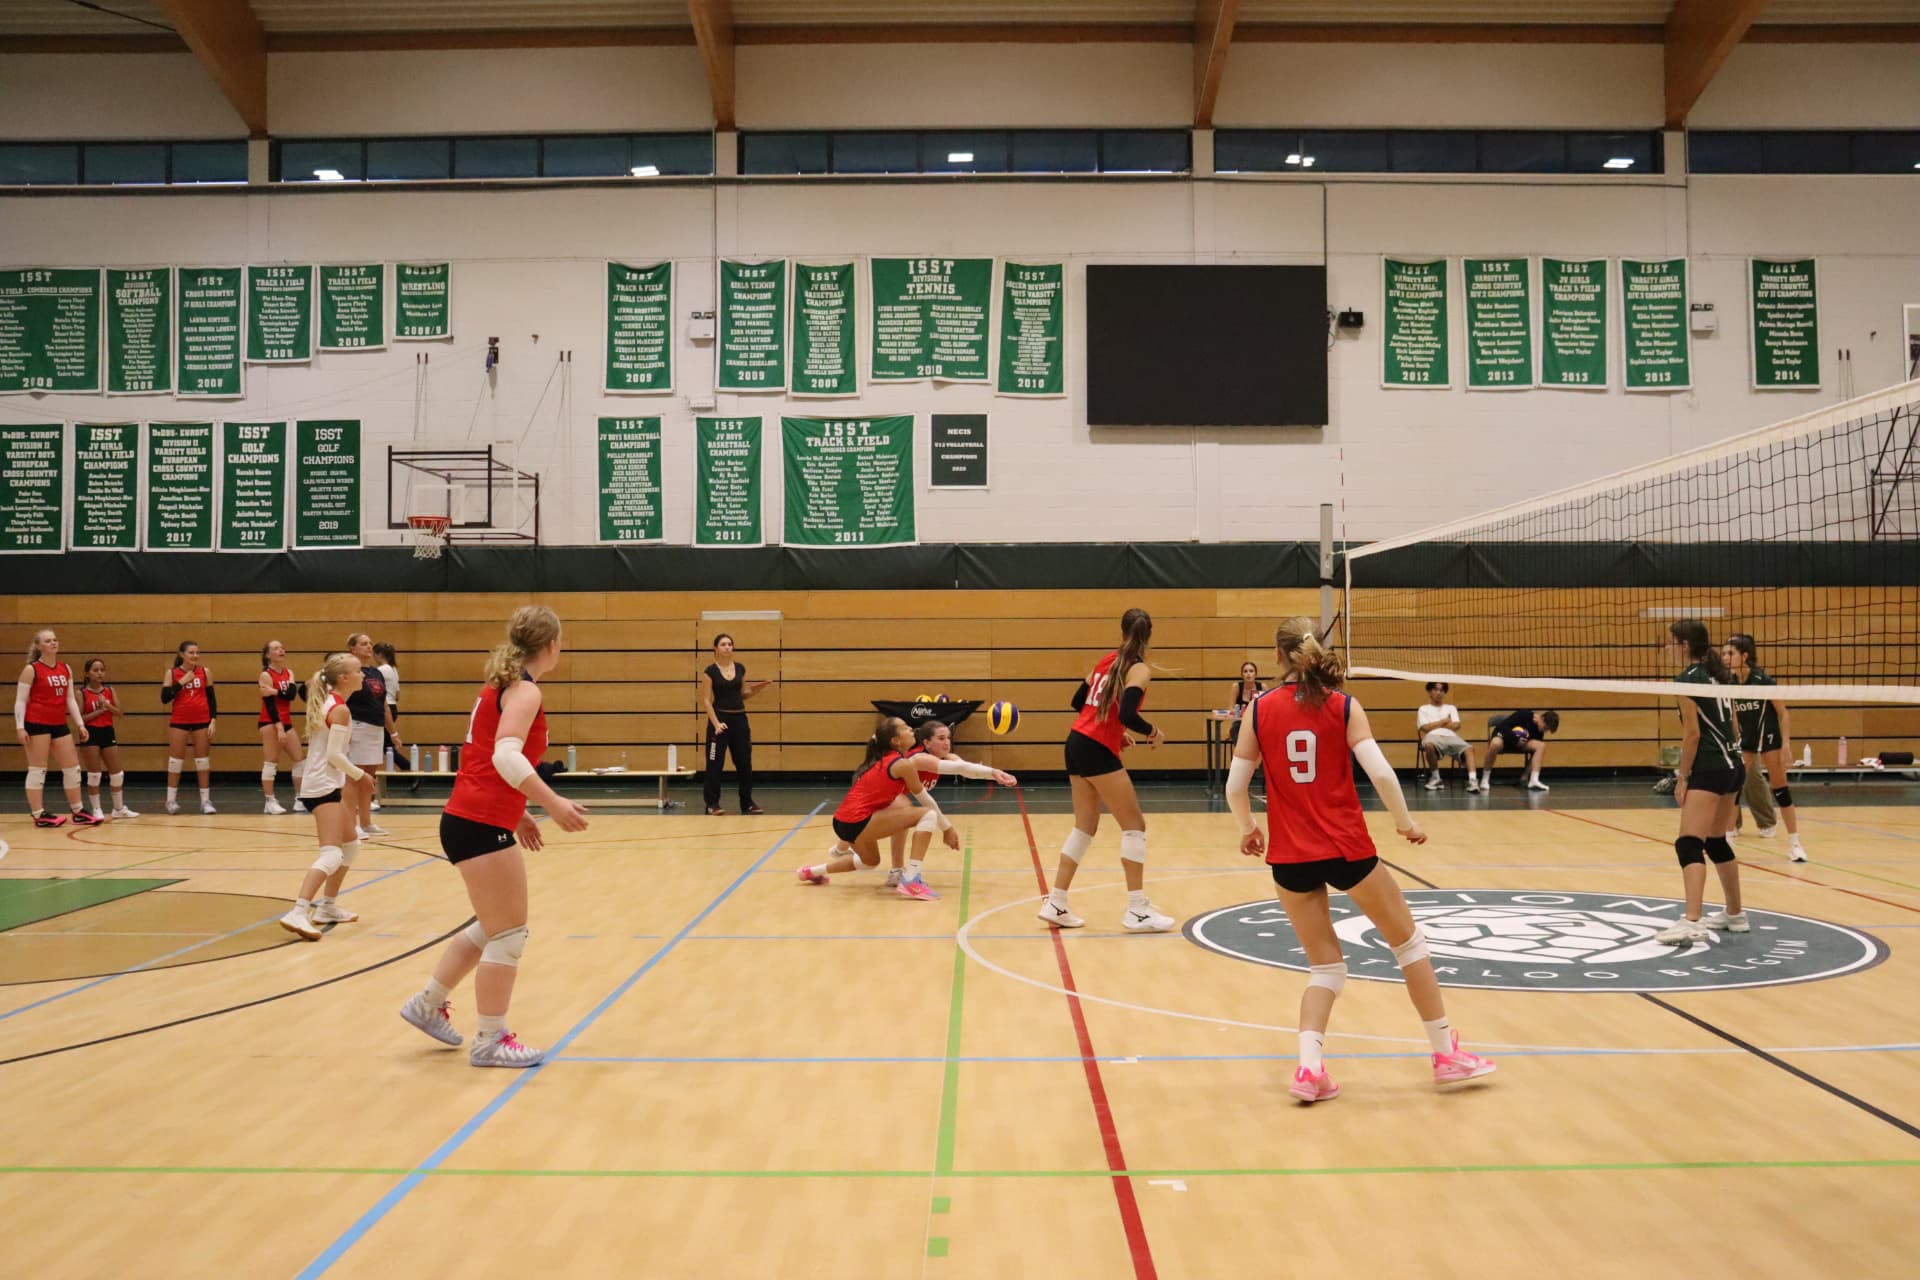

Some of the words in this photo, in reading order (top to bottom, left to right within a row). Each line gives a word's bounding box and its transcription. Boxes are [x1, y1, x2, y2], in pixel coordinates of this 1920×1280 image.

[908, 260, 954, 274] ISST
[1483, 264, 1510, 272] ISST
[1561, 264, 1588, 272] ISST
[1641, 264, 1668, 273] ISST
[126, 272, 152, 280] ISST
[267, 269, 294, 277] ISST
[339, 268, 365, 276] ISST
[626, 272, 654, 280] ISST
[811, 272, 838, 280] ISST
[1019, 272, 1046, 280] ISST
[20, 272, 52, 282] ISST
[198, 277, 223, 285] ISST
[116, 288, 161, 297] SOFTBALL
[907, 284, 956, 294] TENNIS
[804, 290, 844, 298] BASKETBALL
[338, 338, 365, 346] 2008
[265, 349, 293, 357] 2008
[917, 365, 942, 375] 2010
[738, 371, 765, 380] 2009
[1402, 372, 1429, 381] 2012
[1488, 372, 1514, 381] 2013
[1562, 372, 1588, 382] 2013
[1645, 372, 1671, 382] 2013
[1775, 371, 1800, 380] 2014
[1018, 379, 1044, 388] 2010
[616, 421, 644, 430] ISST
[715, 422, 743, 430] ISST
[824, 422, 870, 436] ISST
[91, 429, 122, 440] ISST
[239, 427, 270, 439] ISST
[315, 429, 343, 440] ISST
[806, 437, 843, 447] TRACK
[847, 437, 853, 446] &
[857, 436, 890, 445] FIELD
[242, 443, 265, 452] GOLF
[318, 444, 340, 452] GOLF
[228, 454, 279, 463] CHAMPIONS
[303, 456, 354, 464] CHAMPIONS
[319, 521, 338, 529] 2019
[166, 533, 192, 542] 2017
[241, 531, 266, 540] 2017
[619, 530, 645, 538] 2010
[716, 531, 741, 540] 2011
[835, 532, 864, 542] 2011
[93, 535, 117, 544] 2017
[48, 675, 67, 687] ISB
[1768, 734, 1774, 744] 7
[1286, 730, 1317, 784] 9
[1658, 939, 1808, 978] BELGIUM
